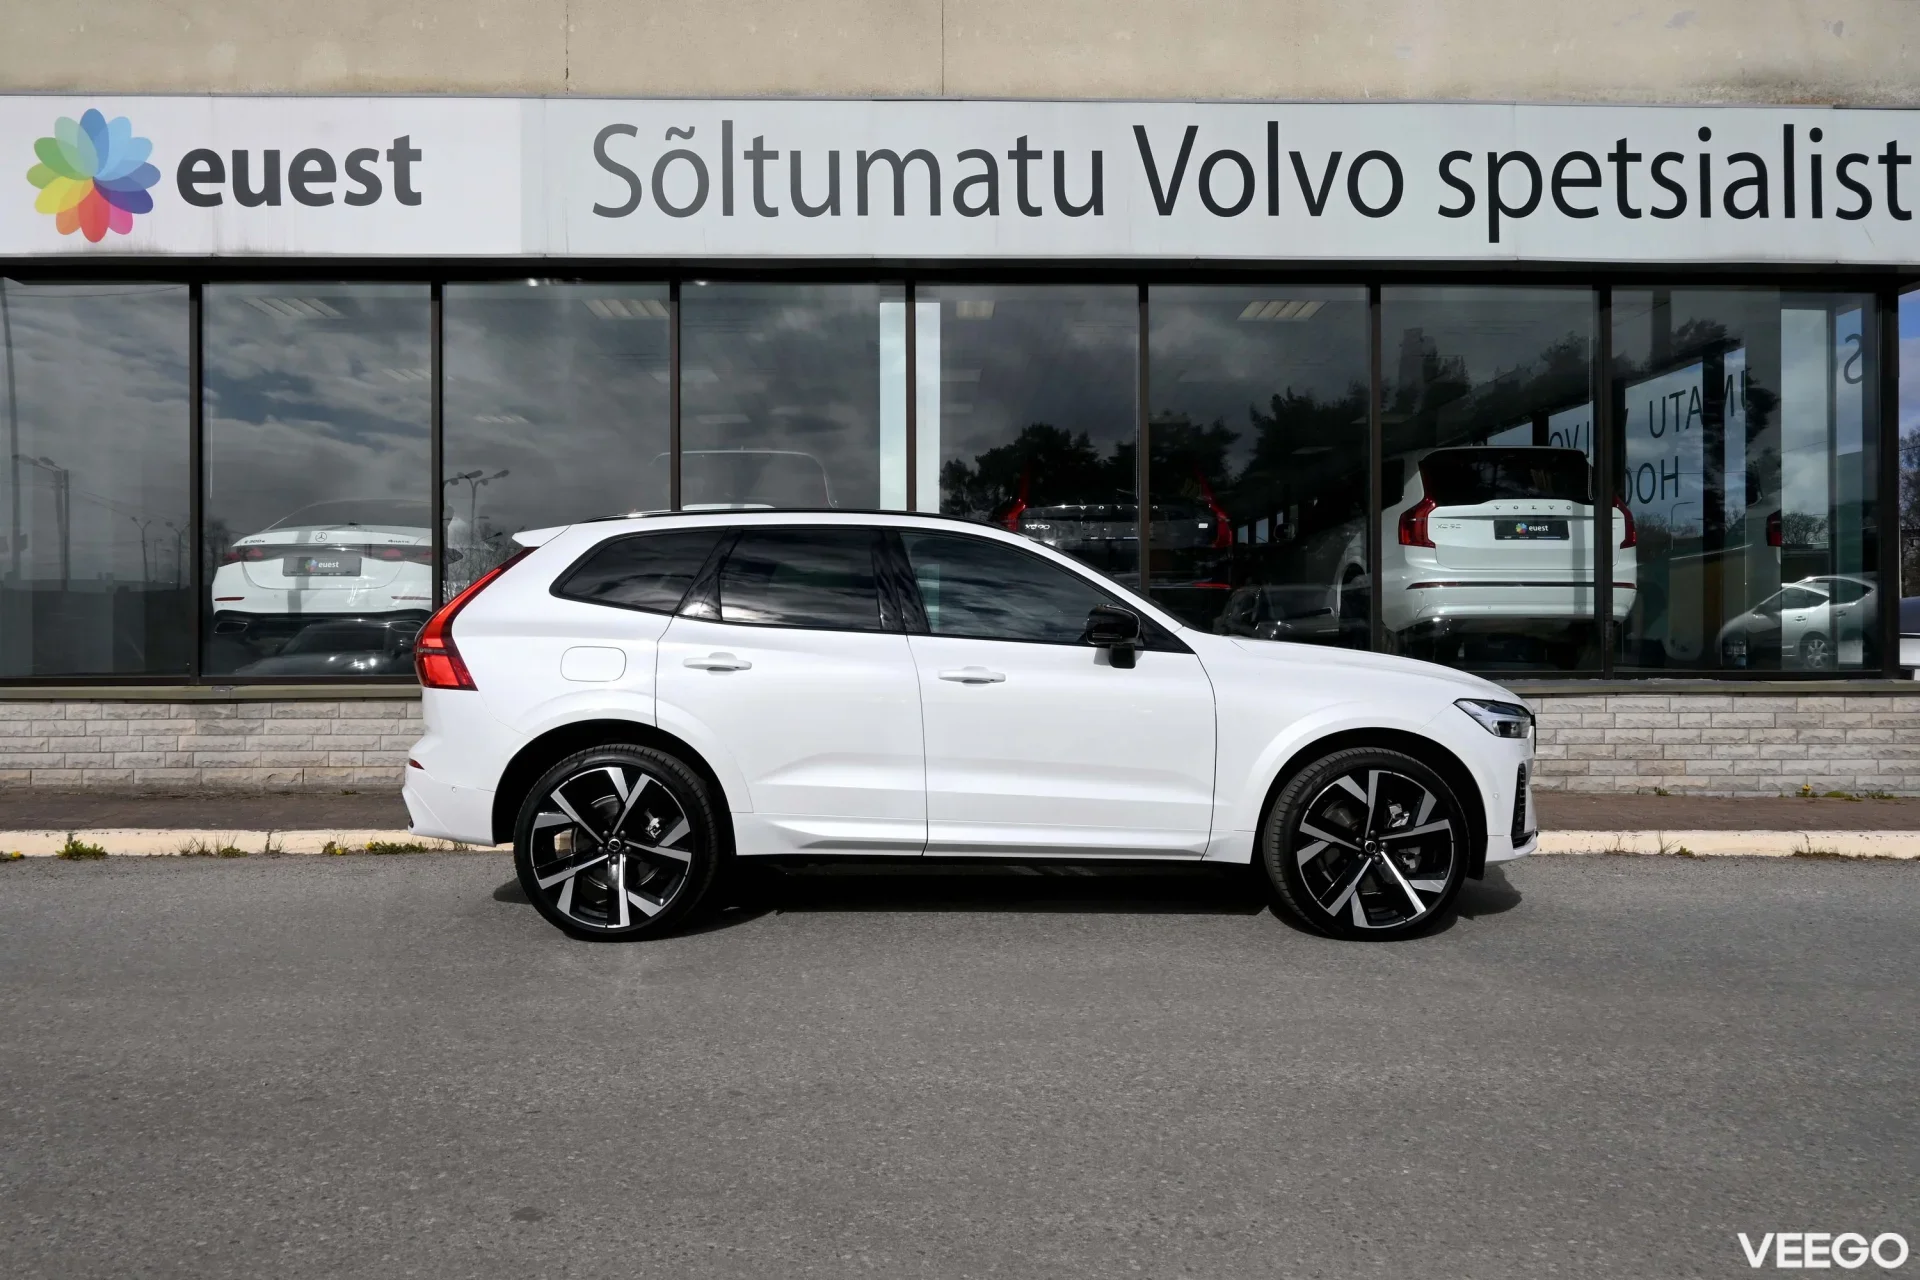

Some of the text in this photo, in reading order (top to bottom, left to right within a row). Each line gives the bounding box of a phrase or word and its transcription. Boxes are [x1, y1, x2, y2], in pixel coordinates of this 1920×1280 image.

[176, 134, 423, 207] euest
[592, 119, 1913, 243] Sõltumatu Volvo spetsialist
